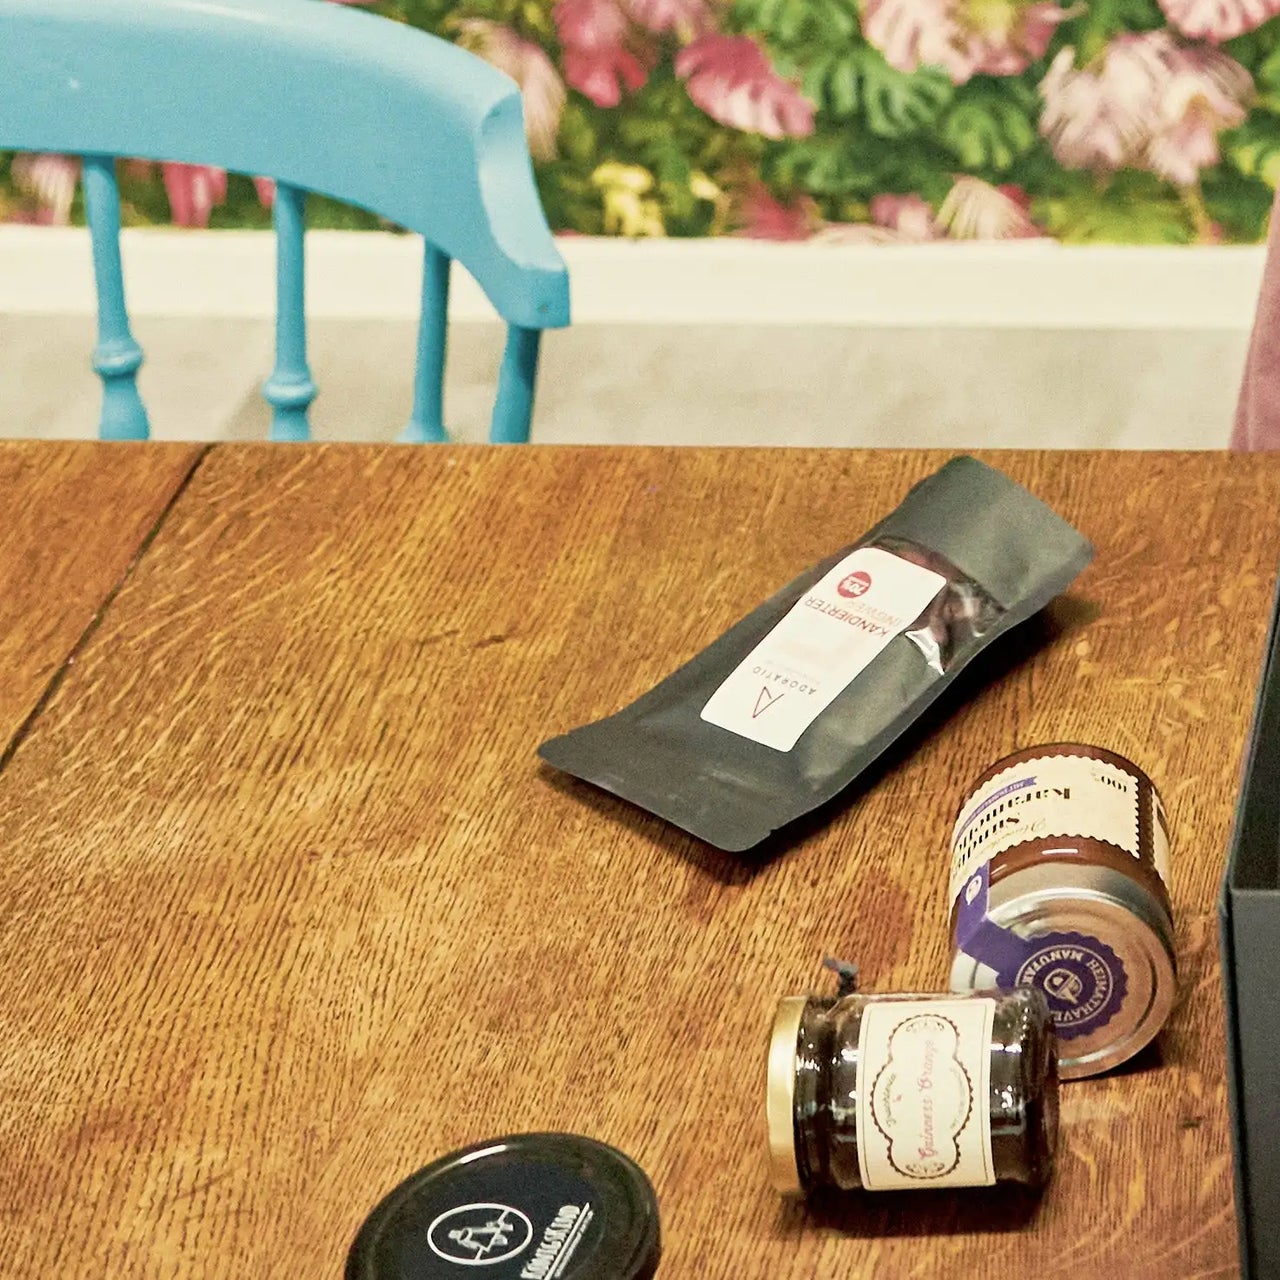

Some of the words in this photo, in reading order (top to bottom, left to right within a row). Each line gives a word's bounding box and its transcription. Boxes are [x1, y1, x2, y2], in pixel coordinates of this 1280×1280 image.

[804, 596, 891, 637] KANDIERTER
[752, 665, 817, 696] ADORATIO
[1050, 958, 1108, 1022] HEIMATHAVE
[917, 1098, 939, 1161] Guinness
